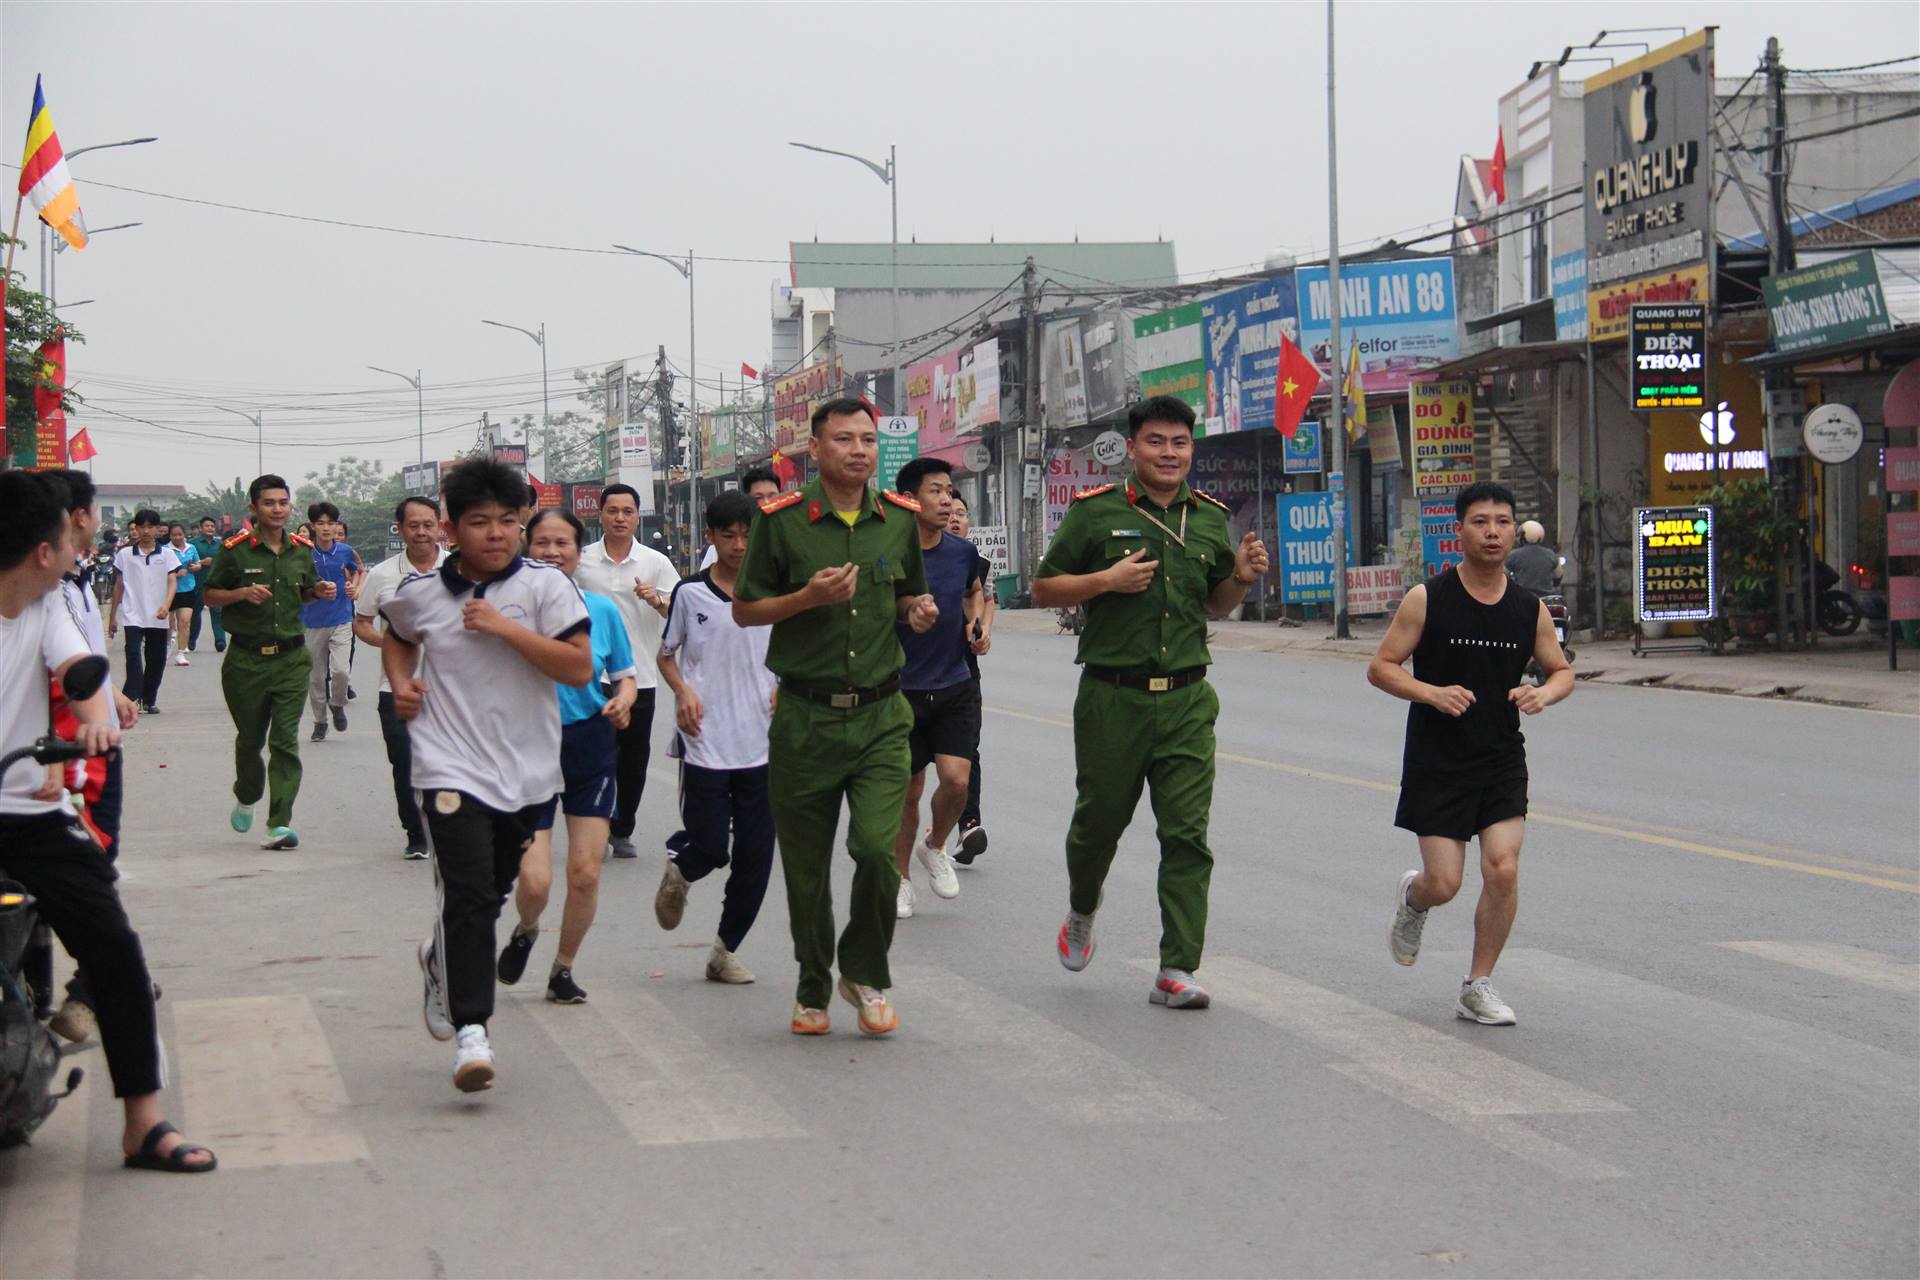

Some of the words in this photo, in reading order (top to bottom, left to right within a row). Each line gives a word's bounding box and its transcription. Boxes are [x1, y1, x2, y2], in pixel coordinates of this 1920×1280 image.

[1309, 276, 1372, 320] MNH
[1378, 274, 1411, 316] AN
[1415, 271, 1446, 313] 88
[1867, 283, 1881, 317] Y
[1636, 309, 1675, 319] QUANG
[1678, 308, 1701, 318] HUY
[1644, 332, 1693, 354] ĐIỆN
[1637, 353, 1702, 373] THOẠI
[1417, 444, 1438, 456] GIA
[1664, 452, 1704, 473] QUANG
[1655, 519, 1694, 535] MUA
[1290, 569, 1325, 587] MINH
[1375, 568, 1402, 588] NEM
